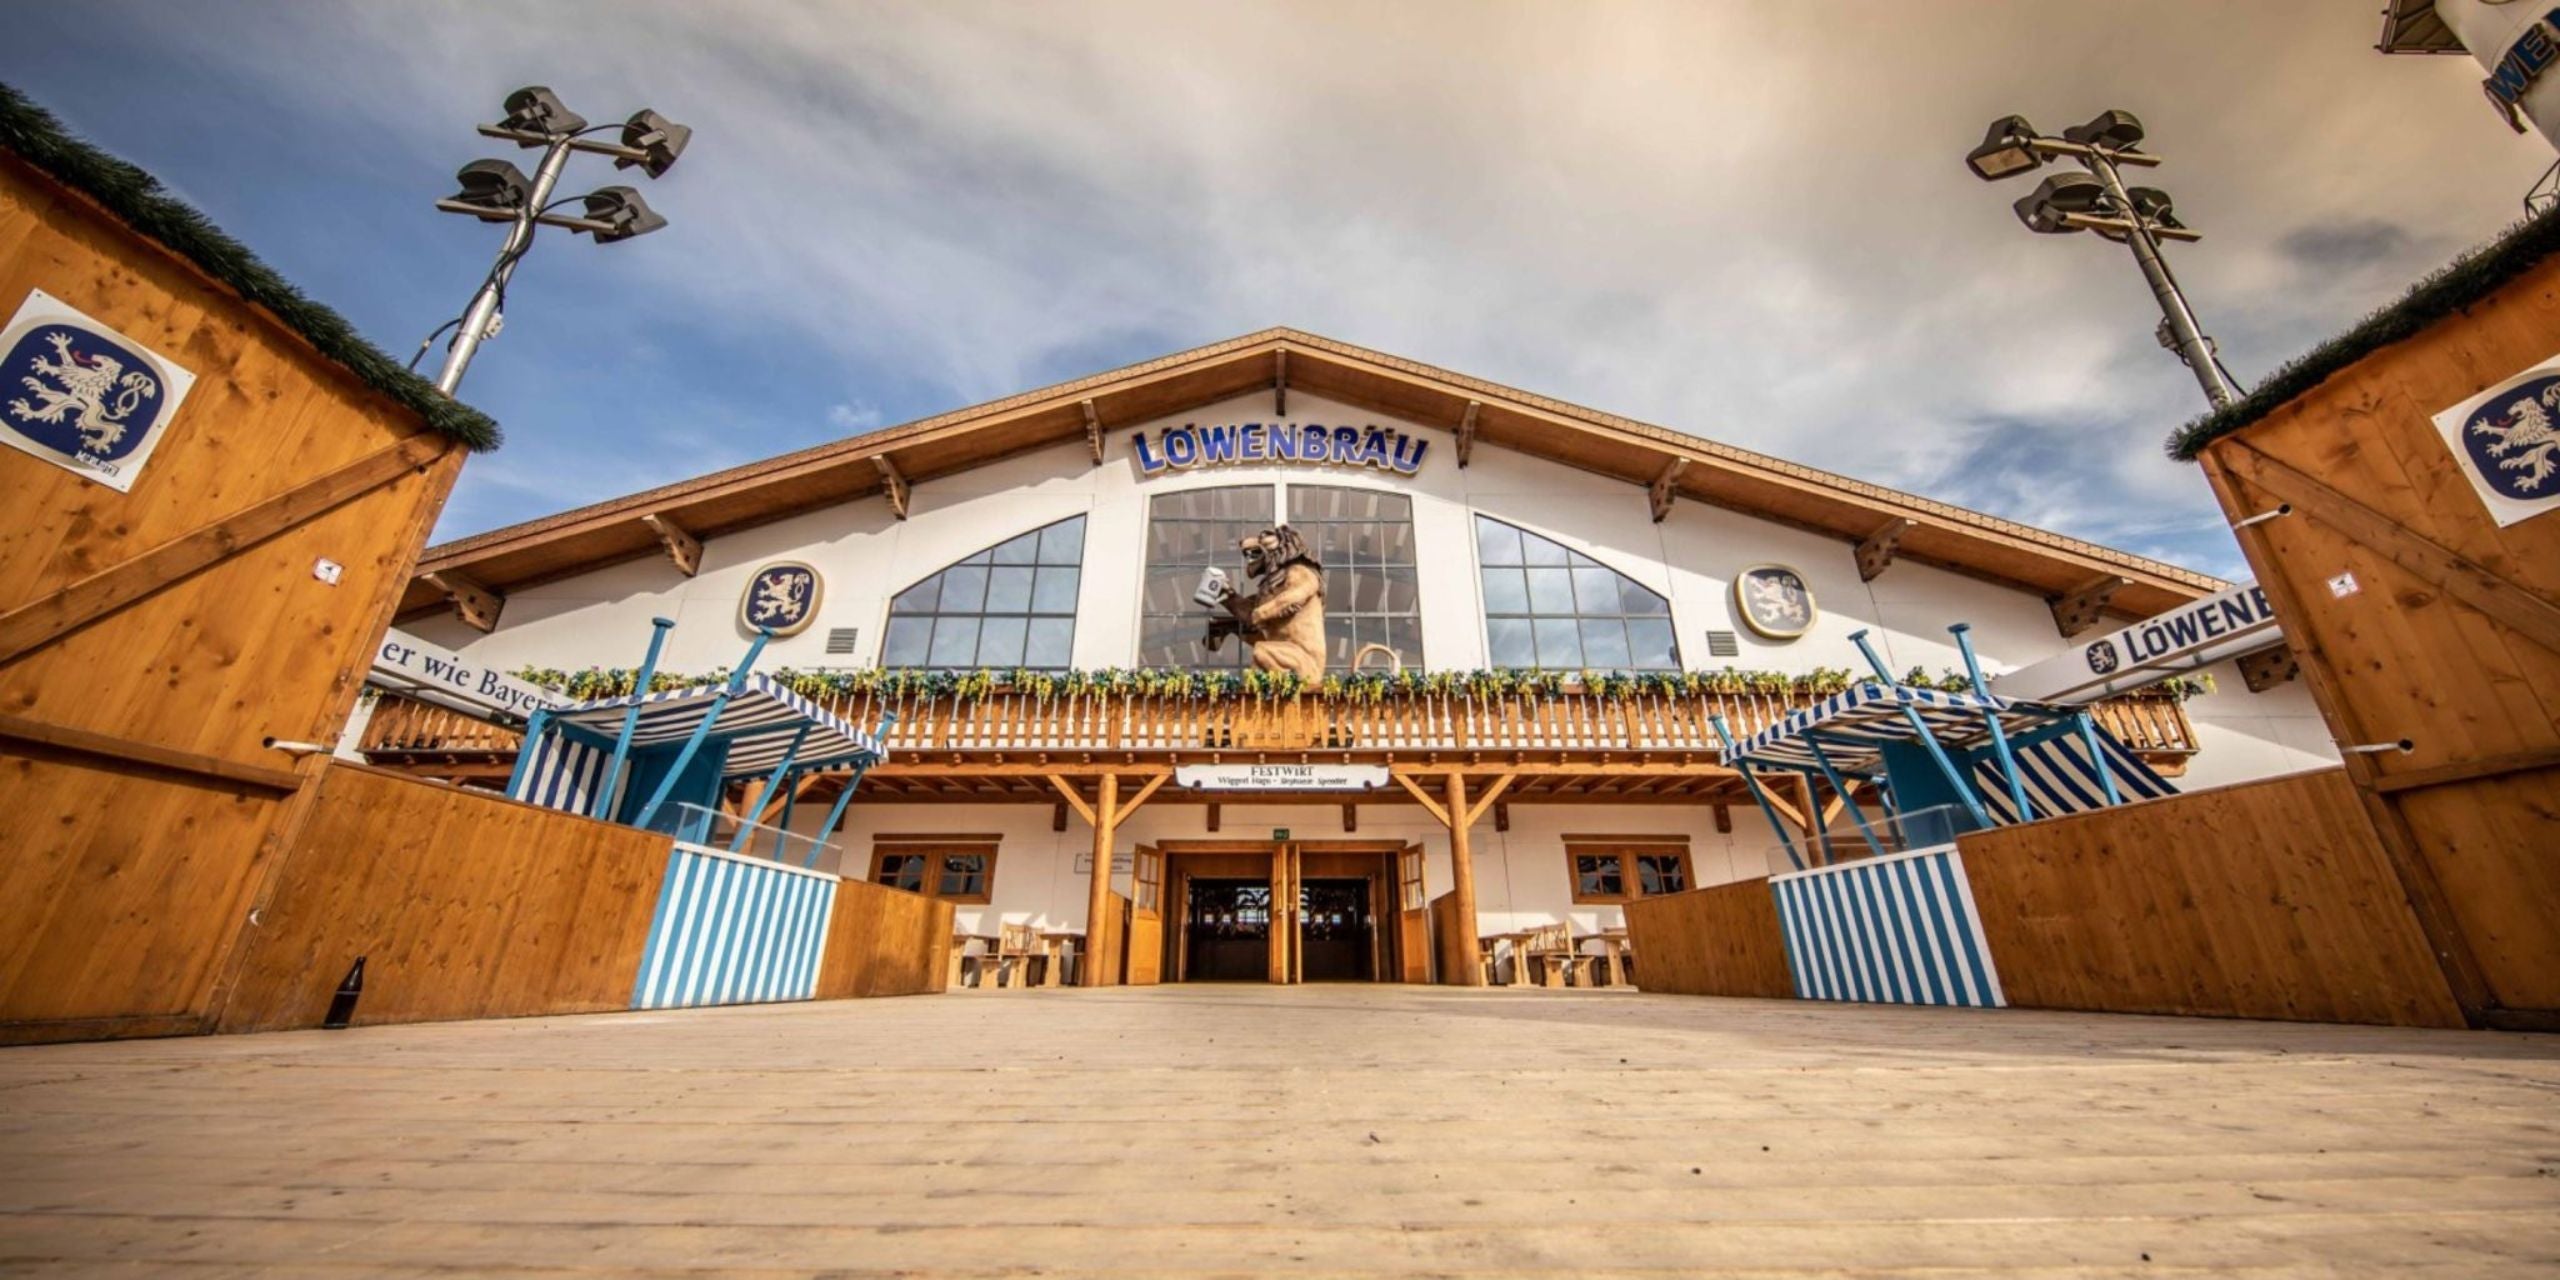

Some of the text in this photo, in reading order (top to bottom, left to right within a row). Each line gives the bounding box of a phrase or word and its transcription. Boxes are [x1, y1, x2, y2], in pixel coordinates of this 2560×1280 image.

[1132, 423, 1429, 475] LÖWENBRÄU
[423, 656, 471, 687] wie
[1251, 766, 1314, 776] FESTWIRT
